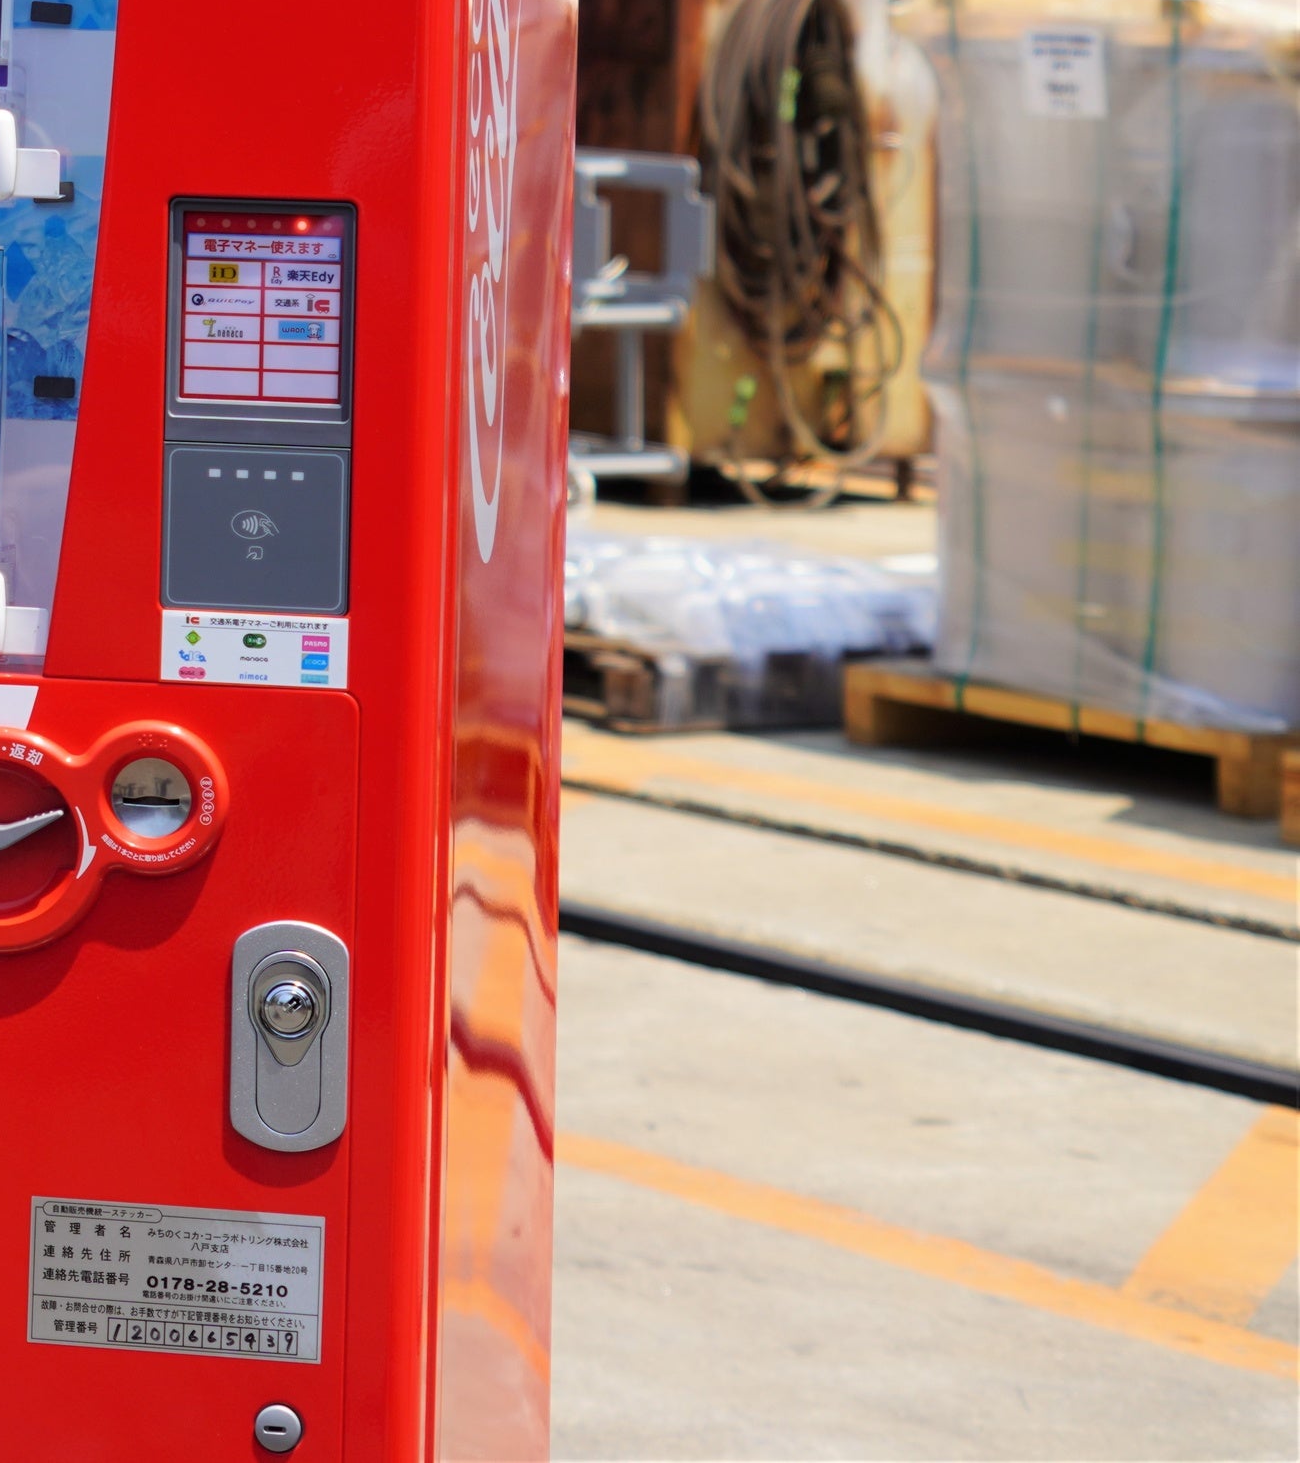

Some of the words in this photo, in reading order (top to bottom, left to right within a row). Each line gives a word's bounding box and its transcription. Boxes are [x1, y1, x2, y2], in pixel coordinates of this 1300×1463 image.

[204, 239, 324, 255] 電子マネー使えます
[287, 270, 334, 283] 楽天Edy
[210, 617, 328, 630] 交通系電子マネーご利用になれます
[239, 672, 268, 681] nimoca
[53, 1205, 153, 1218] 自動販売機統一ステッカー
[191, 1242, 229, 1254] 八戸支店
[42, 1268, 130, 1286] 連絡先電話番号
[146, 1275, 288, 1298] 0178-28-5210
[54, 1319, 98, 1334] 管理番号
